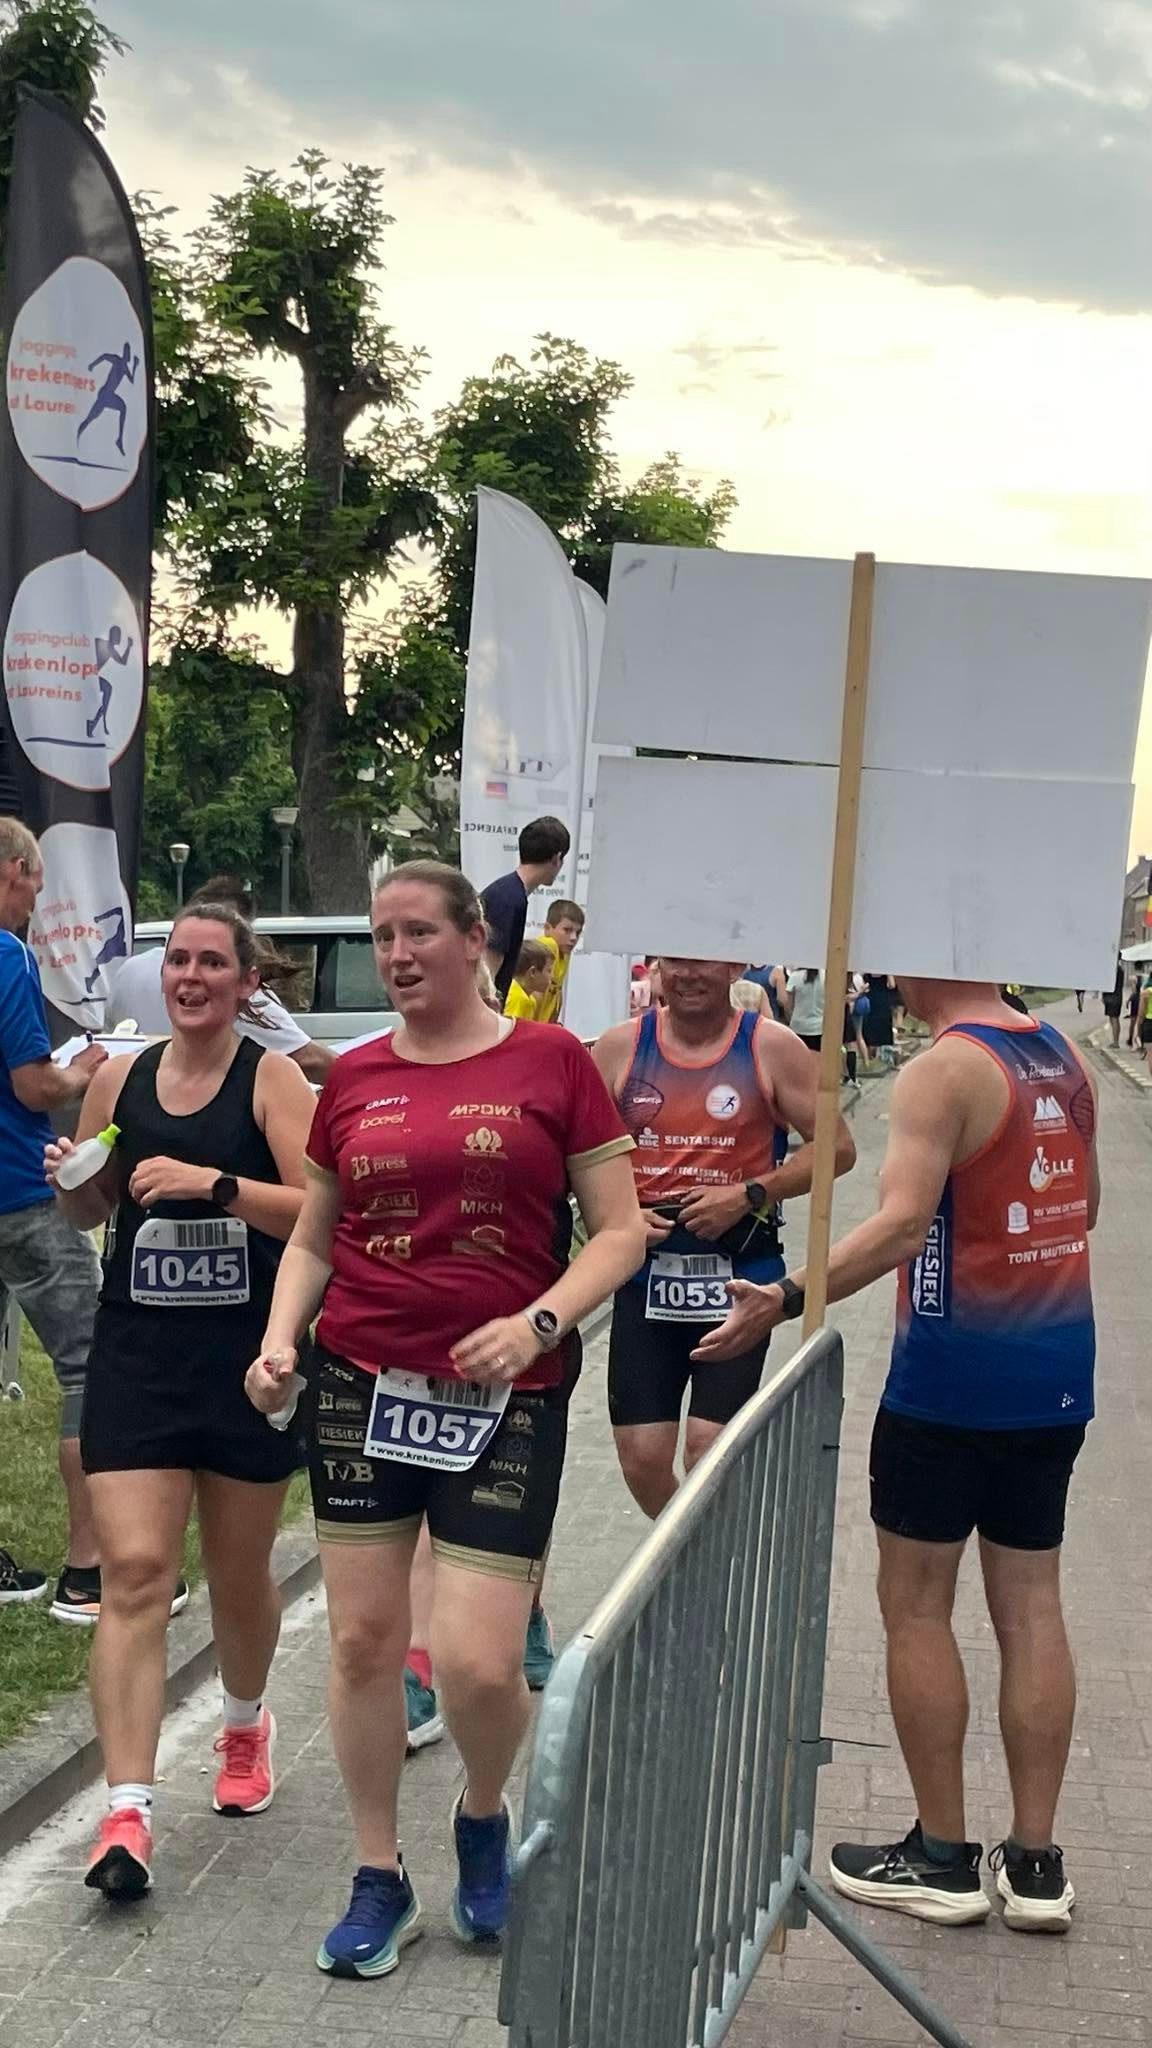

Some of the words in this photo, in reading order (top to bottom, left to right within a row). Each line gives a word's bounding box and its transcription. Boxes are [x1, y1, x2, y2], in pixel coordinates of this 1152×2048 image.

[460, 1199, 503, 1215] MKH
[1008, 1250, 1038, 1264] TONY
[140, 1254, 240, 1287] 1045
[654, 1280, 728, 1308] 1053
[384, 1404, 494, 1453] 1057
[489, 1459, 528, 1475] MKH
[327, 1497, 366, 1507] CRAFT
